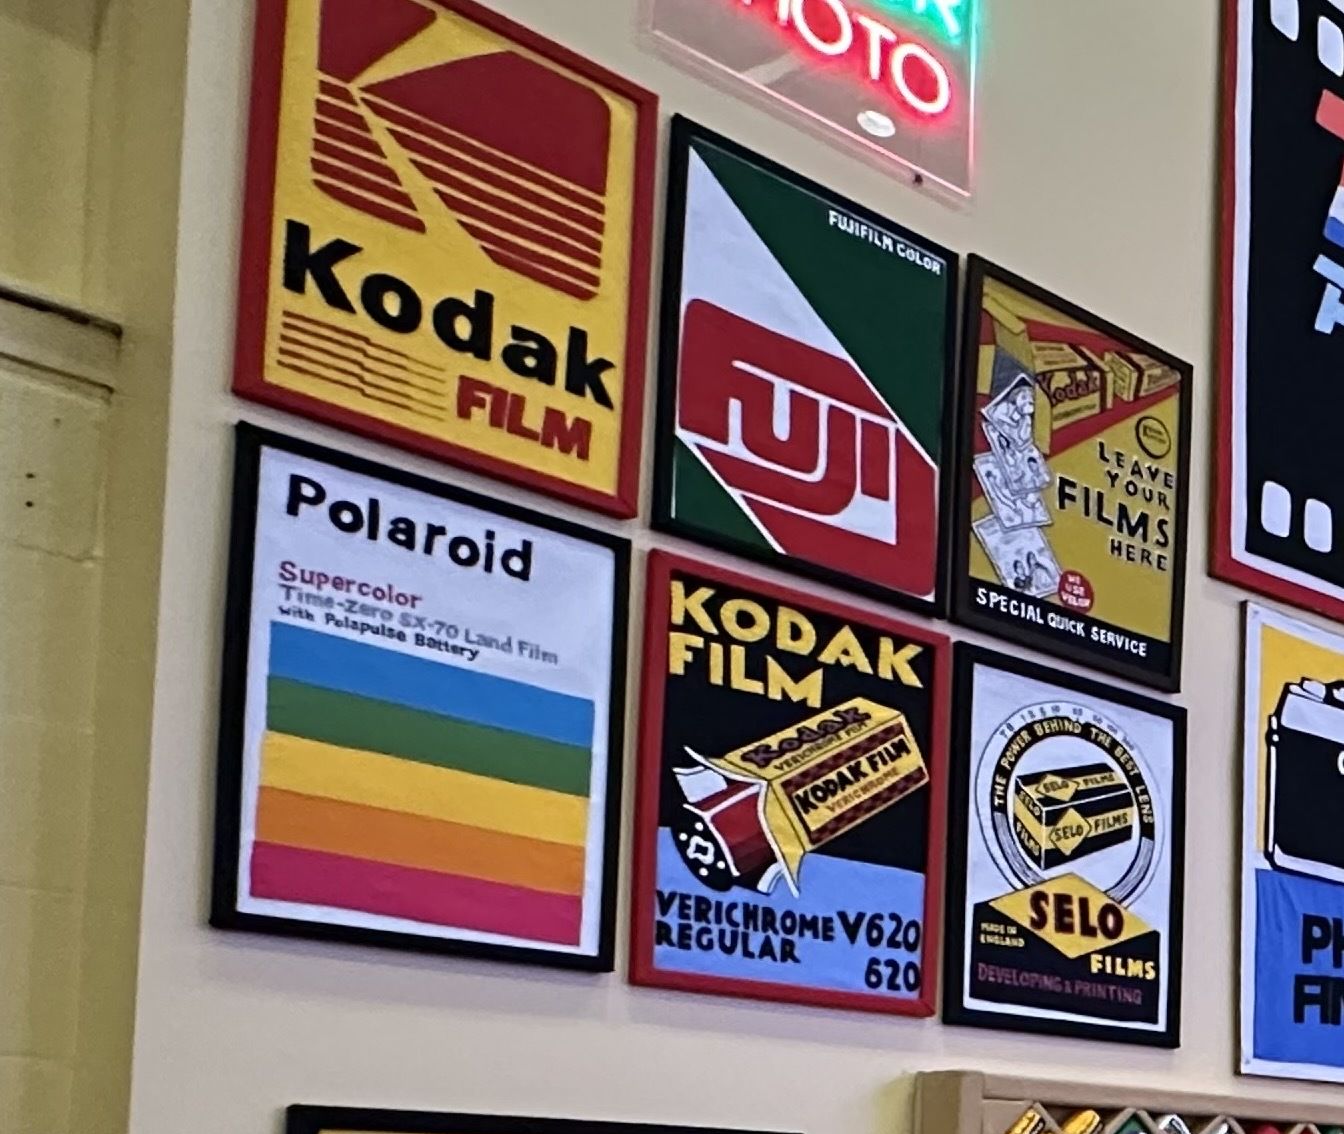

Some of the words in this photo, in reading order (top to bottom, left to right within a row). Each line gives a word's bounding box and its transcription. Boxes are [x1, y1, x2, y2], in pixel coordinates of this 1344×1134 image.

[742, 0, 951, 114] OTO
[828, 209, 894, 253] FUJIFILM
[896, 243, 942, 276] COLOR
[282, 218, 617, 411] Kodak
[456, 374, 594, 461] FILM
[1098, 439, 1175, 490] LEAVE
[1056, 475, 1170, 549] FILMS
[1106, 469, 1170, 512] YOUR
[286, 473, 534, 582] Polaroid
[1110, 537, 1168, 572] HERE
[278, 560, 423, 610] Supercolor
[278, 605, 316, 623] with
[324, 612, 407, 643] Polapulse
[414, 632, 480, 662] Battery
[398, 611, 460, 641] SX-70
[464, 628, 513, 655] Land
[517, 641, 560, 666] Film
[670, 579, 924, 689] KODAK
[976, 586, 1045, 625] SPECIAL
[1047, 611, 1086, 638] QUICK
[1090, 626, 1148, 658] SERVICE
[668, 631, 824, 710] FILM
[740, 706, 872, 769] Kodak
[1000, 730, 1032, 770] POWER
[1032, 718, 1083, 737] BEHIND
[1090, 726, 1113, 749] THE
[797, 763, 868, 816] KODAK
[869, 735, 911, 775] FILM
[1113, 746, 1140, 776] BEST
[826, 767, 900, 815] VERICHROME
[994, 774, 1007, 807] THE
[1134, 784, 1154, 824] LENS
[1053, 823, 1084, 842] SELO
[1093, 812, 1129, 833] FILMS
[655, 890, 835, 943] VERICHROME
[836, 910, 921, 954] V620
[1029, 890, 1124, 940] SELO
[654, 920, 801, 965] REGULAR
[1090, 954, 1156, 981] FILMS
[864, 956, 921, 992] 620
[977, 961, 1063, 996] DEVELOPING
[1074, 982, 1143, 1006] PRINTING
